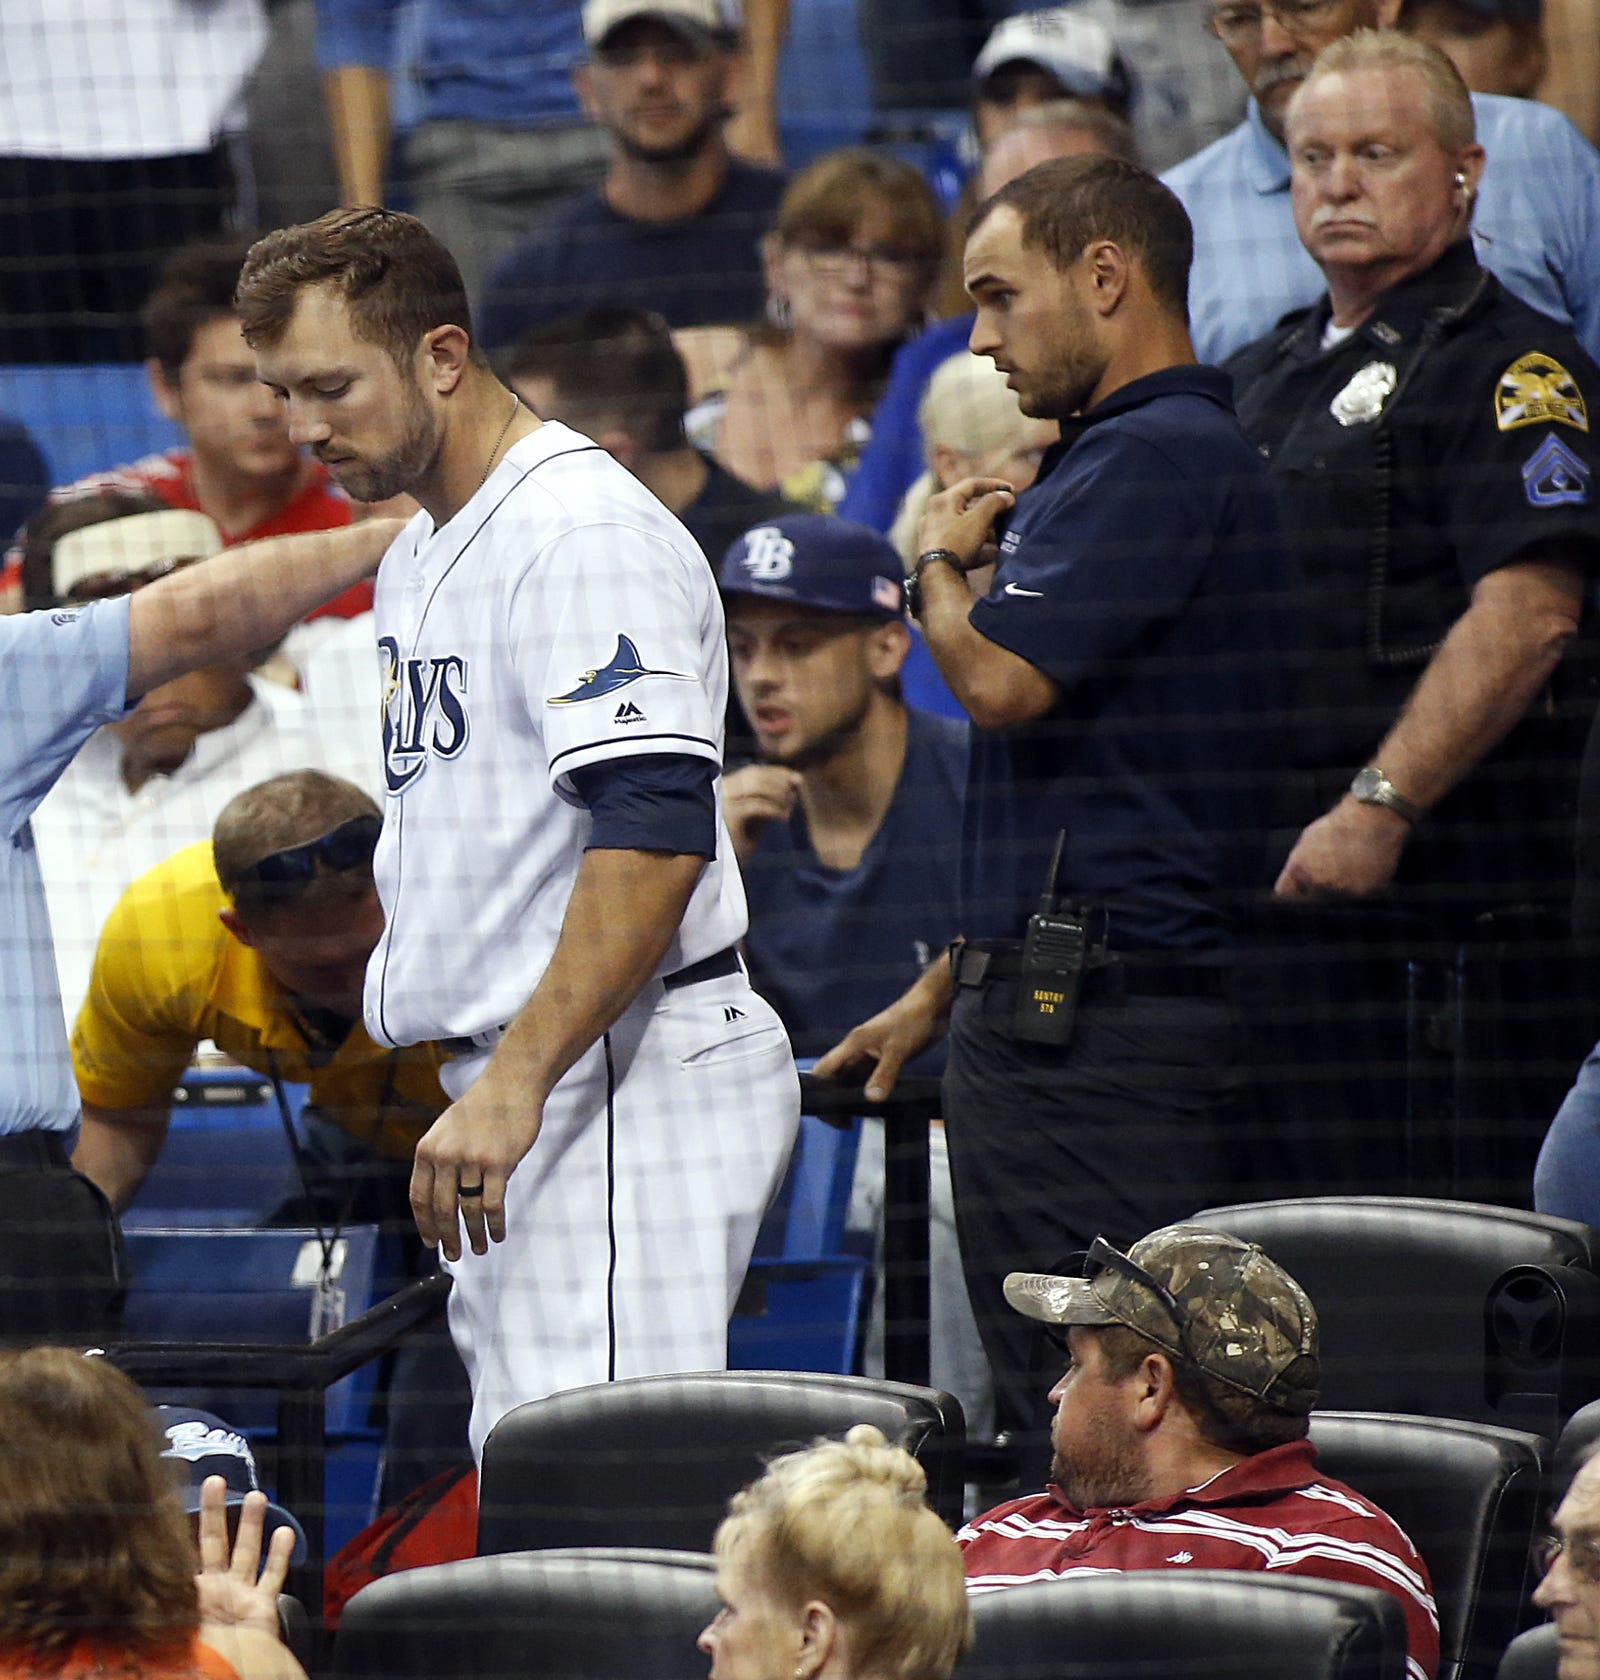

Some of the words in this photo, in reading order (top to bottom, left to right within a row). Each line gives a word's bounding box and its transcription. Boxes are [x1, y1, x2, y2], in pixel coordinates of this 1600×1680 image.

[740, 526, 795, 580] TB
[378, 634, 471, 794] RYS
[1033, 989, 1065, 1003] SENTRY
